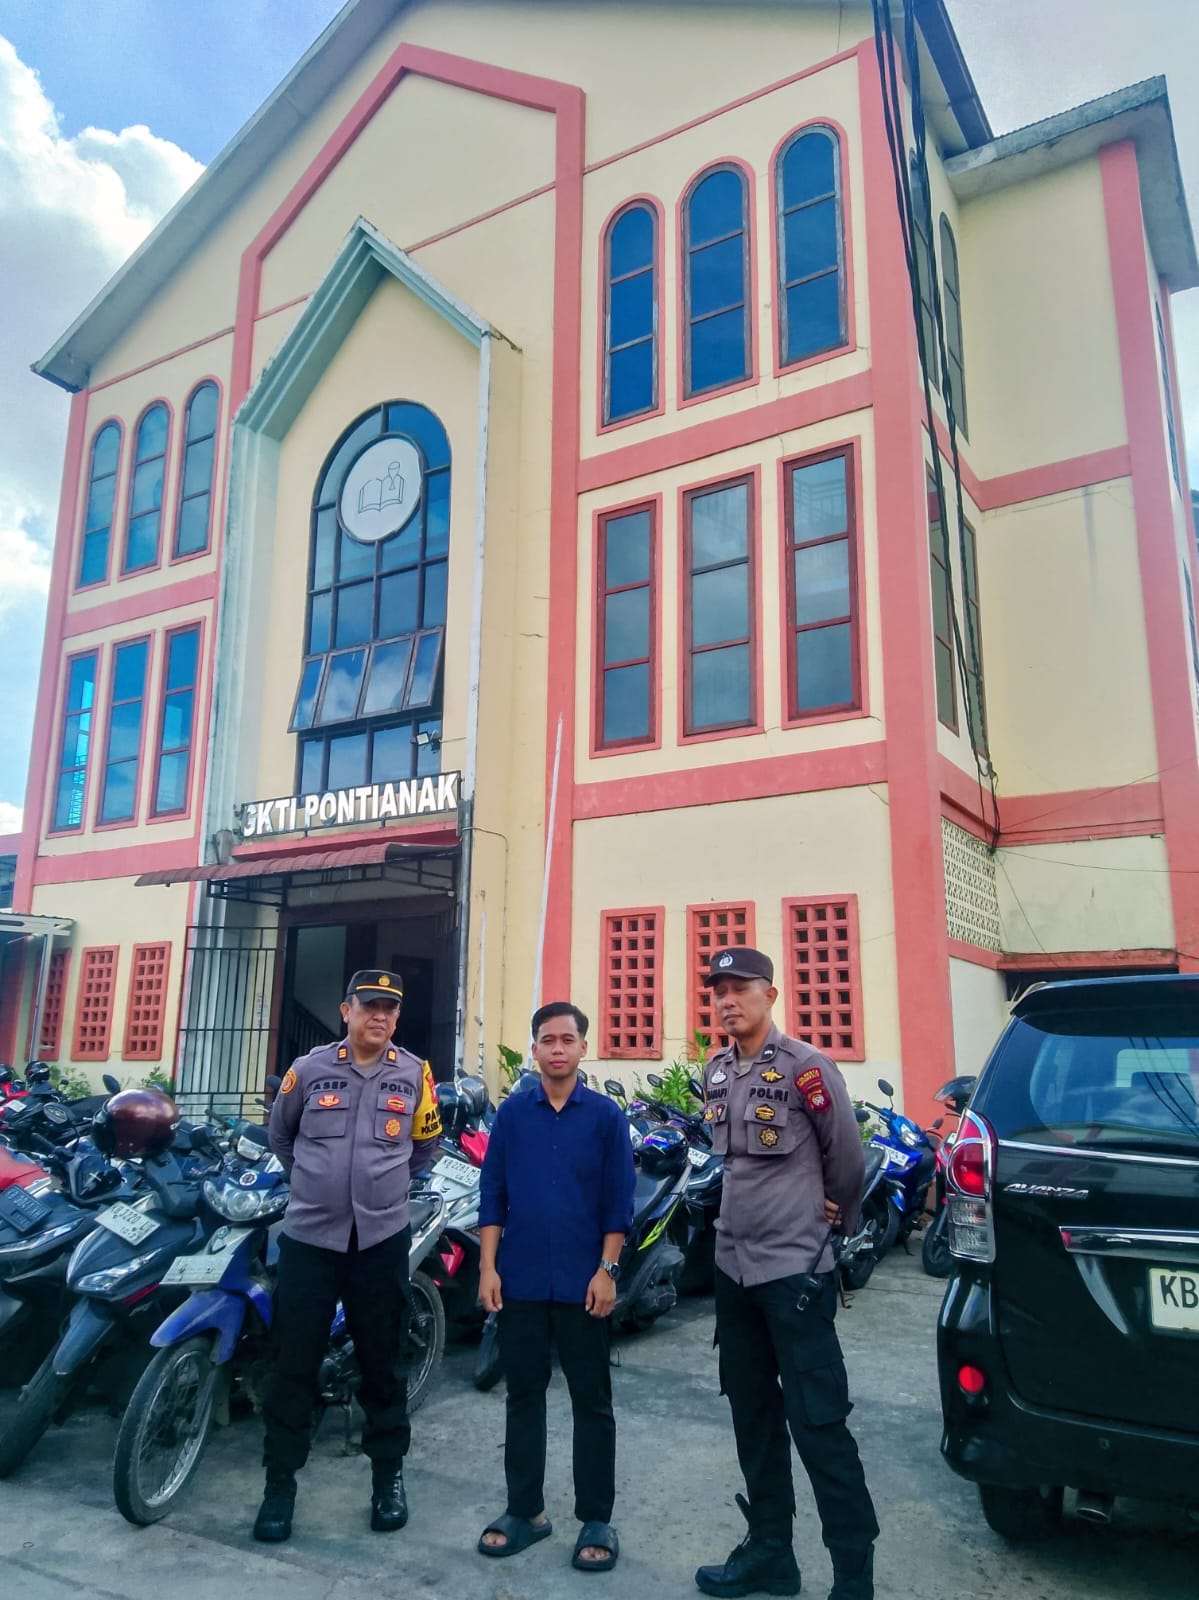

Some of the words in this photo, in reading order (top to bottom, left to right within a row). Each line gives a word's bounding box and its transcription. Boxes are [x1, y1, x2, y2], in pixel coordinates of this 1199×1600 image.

[306, 772, 459, 828] PONTIANAK
[312, 1081, 348, 1092] ASEP
[380, 1082, 413, 1097] POLRI
[749, 1087, 789, 1102] POLRI
[1002, 1183, 1089, 1200] AVANZA
[1160, 1274, 1199, 1309] KB
